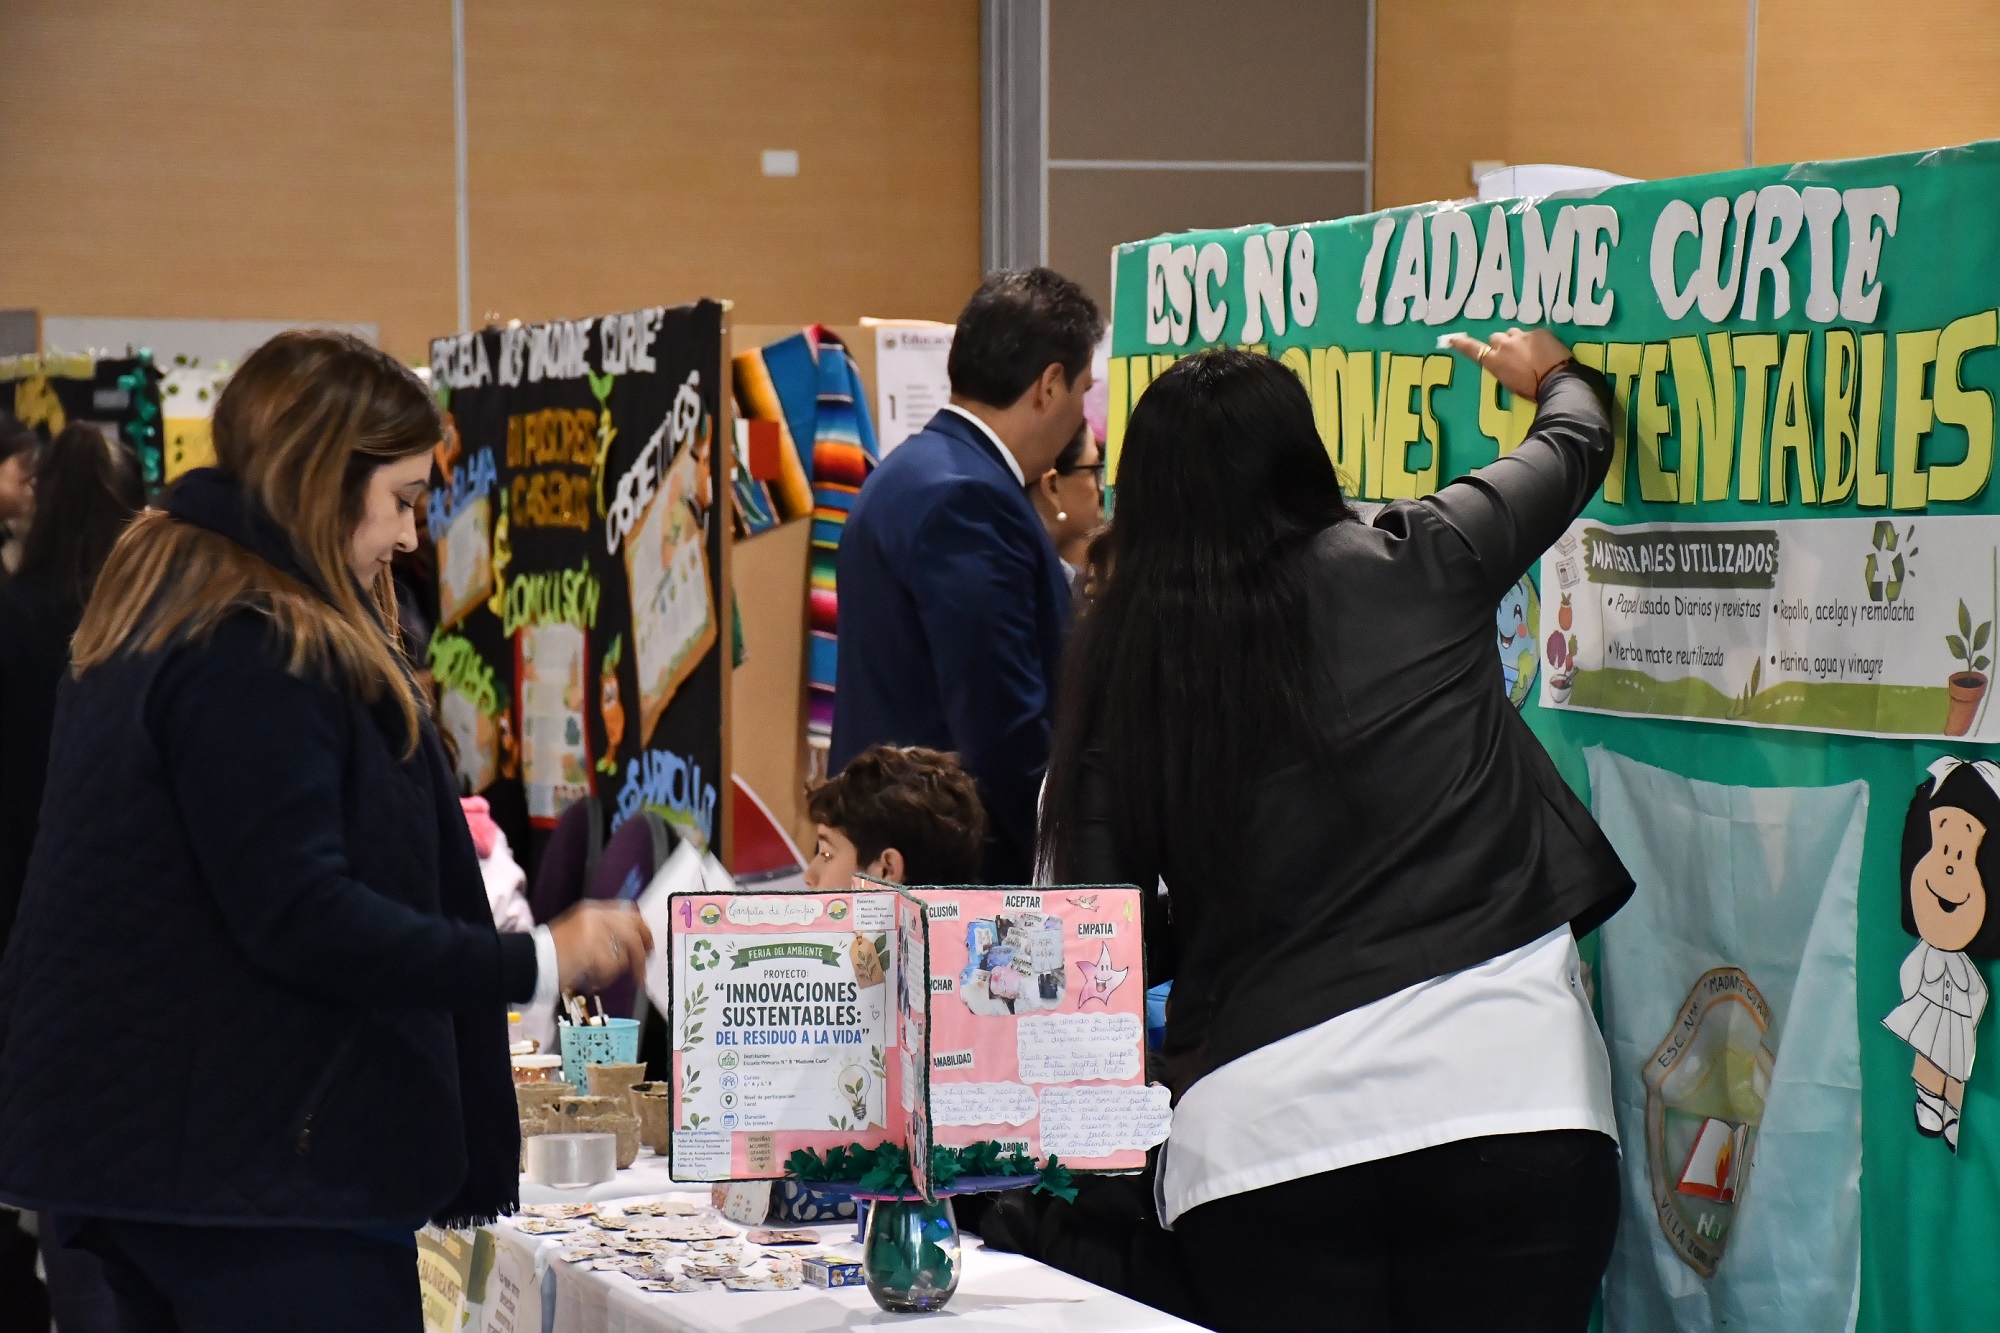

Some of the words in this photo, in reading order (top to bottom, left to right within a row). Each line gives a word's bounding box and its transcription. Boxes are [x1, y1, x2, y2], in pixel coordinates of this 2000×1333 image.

[1146, 241, 1229, 346] ESC
[1650, 185, 1900, 324] CURIE
[1680, 539, 1774, 574] UTILIZADOS
[1615, 593, 1640, 619] Papel
[1640, 595, 1670, 616] usado
[1675, 595, 1712, 617] Diarios
[1714, 602, 1721, 622] y
[1722, 598, 1761, 618] revistas
[1816, 598, 1849, 627] acelga
[1851, 604, 1858, 627] y
[1861, 599, 1914, 622] remolacha
[1614, 641, 1643, 662] Yerba
[1646, 646, 1672, 664] mate
[1676, 645, 1724, 667] reutilizada
[1780, 651, 1812, 676] Harina,
[1814, 657, 1837, 679] agua
[1839, 658, 1846, 680] y
[1848, 653, 1884, 681] vinagre
[769, 902, 780, 915] de
[1005, 895, 1041, 909] ACEPTAR
[1078, 923, 1113, 936] EMPATIA
[749, 949, 771, 959] FERIA
[774, 947, 785, 956] DEL
[764, 969, 809, 979] PROYECTO:
[722, 1005, 862, 1027] SUSTENTABLES:
[716, 1031, 738, 1045] DEL
[744, 1030, 797, 1045] RESIDUO
[801, 1030, 810, 1044] A
[814, 1030, 829, 1044] LA
[933, 1052, 972, 1068] AMABILIDAD
